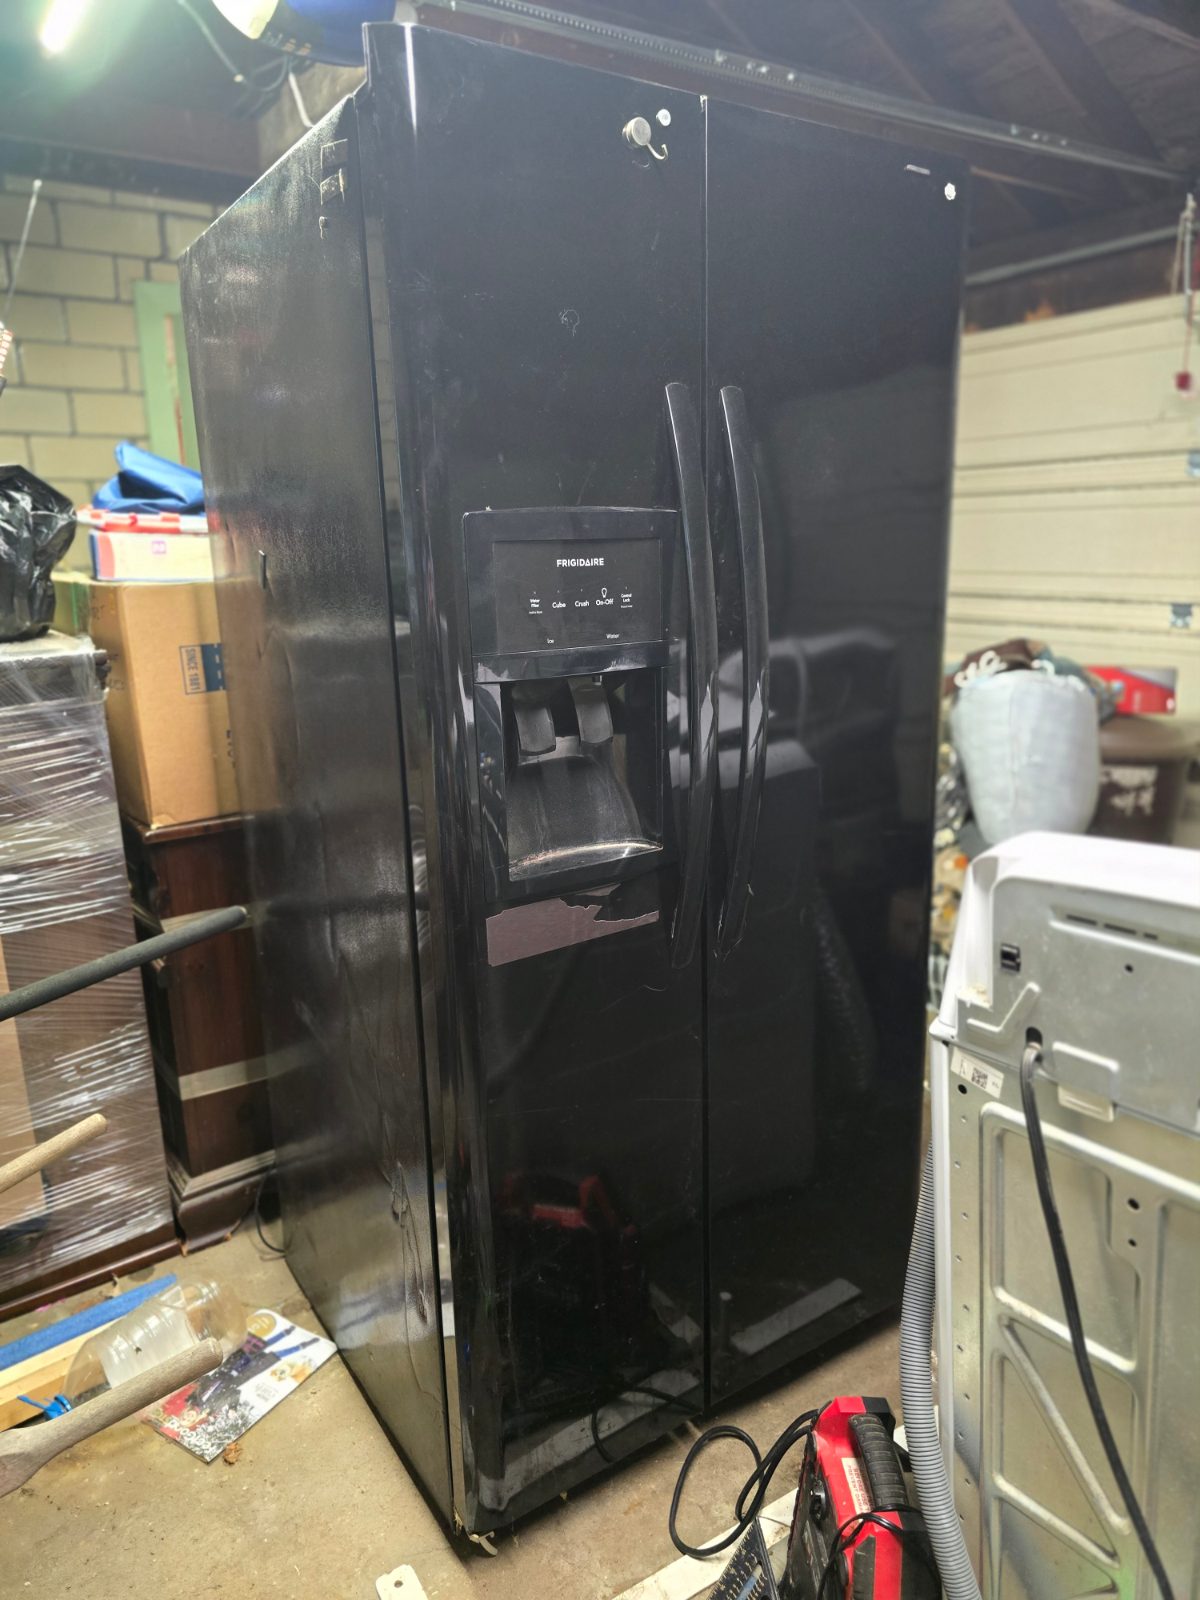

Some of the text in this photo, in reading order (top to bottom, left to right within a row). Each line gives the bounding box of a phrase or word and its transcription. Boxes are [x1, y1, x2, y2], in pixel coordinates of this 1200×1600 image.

[556, 557, 605, 568] FRIGIDAIRE
[552, 601, 566, 609] Cube
[574, 599, 590, 607] Crush
[595, 598, 614, 606] On-Off
[854, 1493, 864, 1511] DAMA
